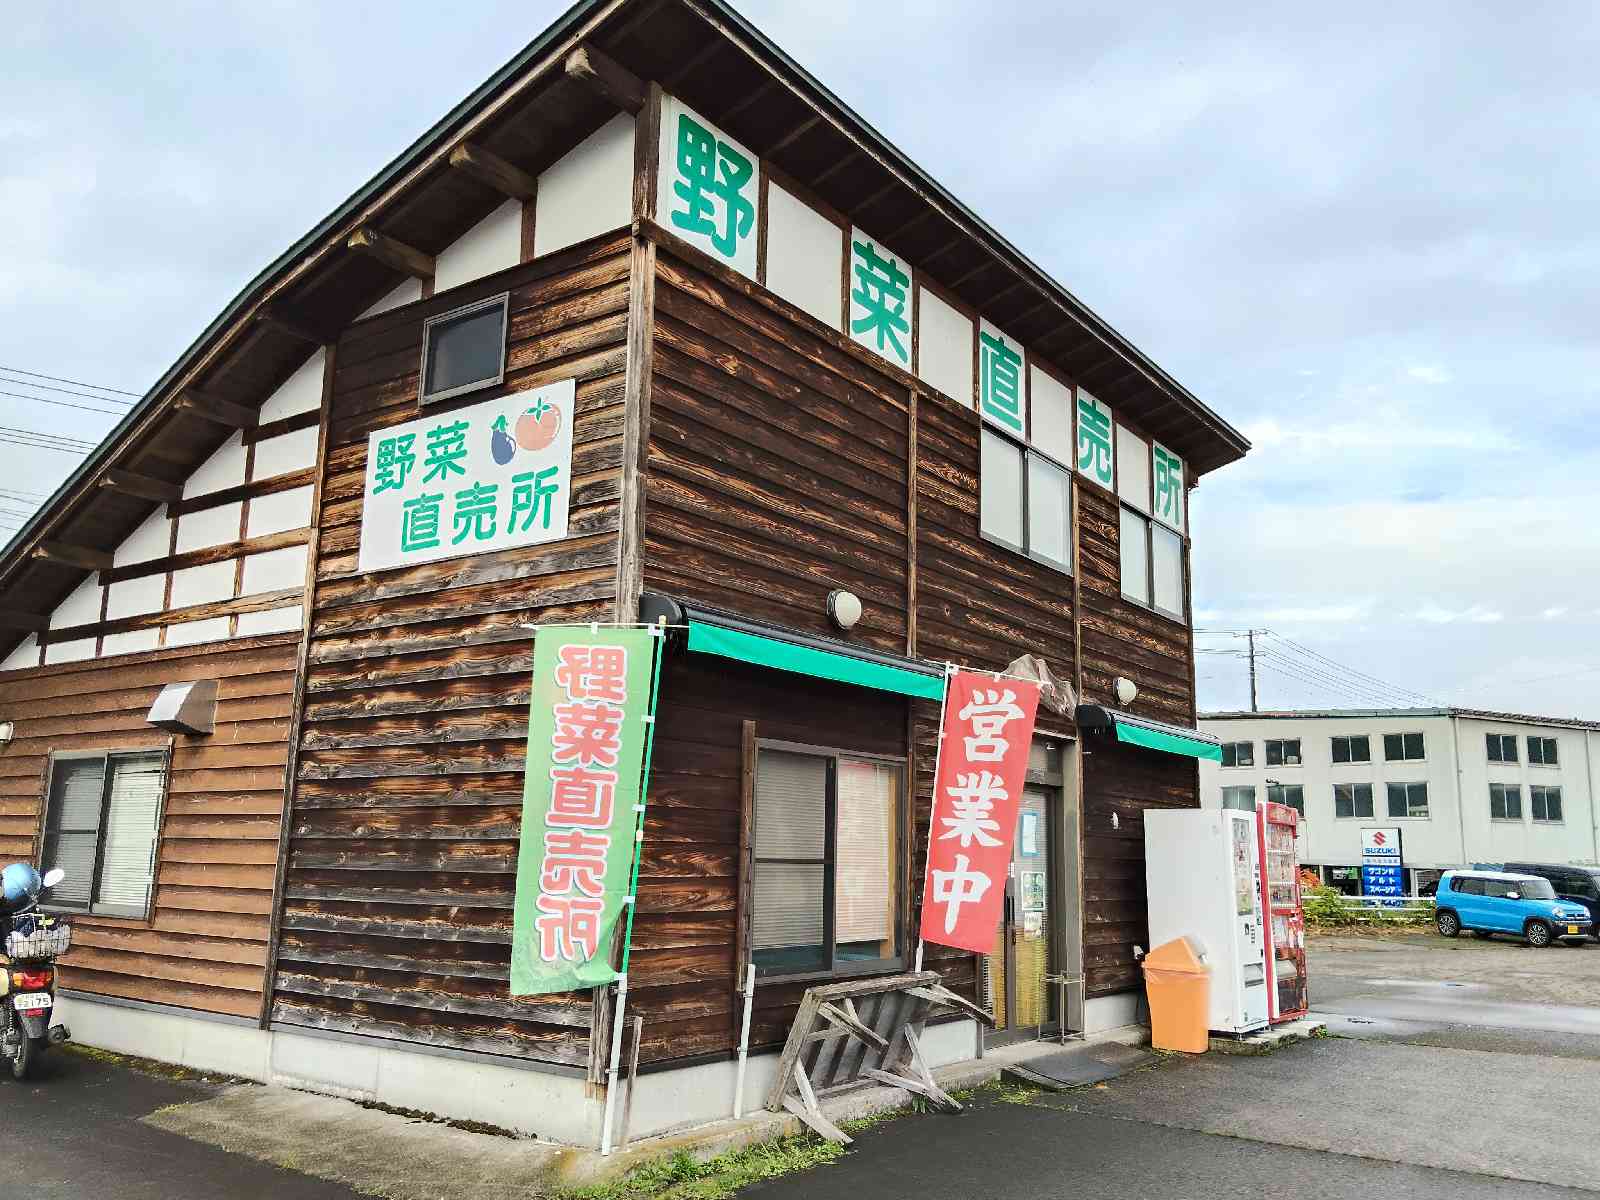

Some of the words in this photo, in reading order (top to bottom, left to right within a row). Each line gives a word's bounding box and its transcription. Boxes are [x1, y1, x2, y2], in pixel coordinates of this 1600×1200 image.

[671, 113, 1184, 526] 野菜直売所
[373, 420, 469, 495] 野菜
[401, 466, 559, 552] 直売所
[931, 688, 1025, 935] 営業中
[1369, 876, 1396, 885] アルト
